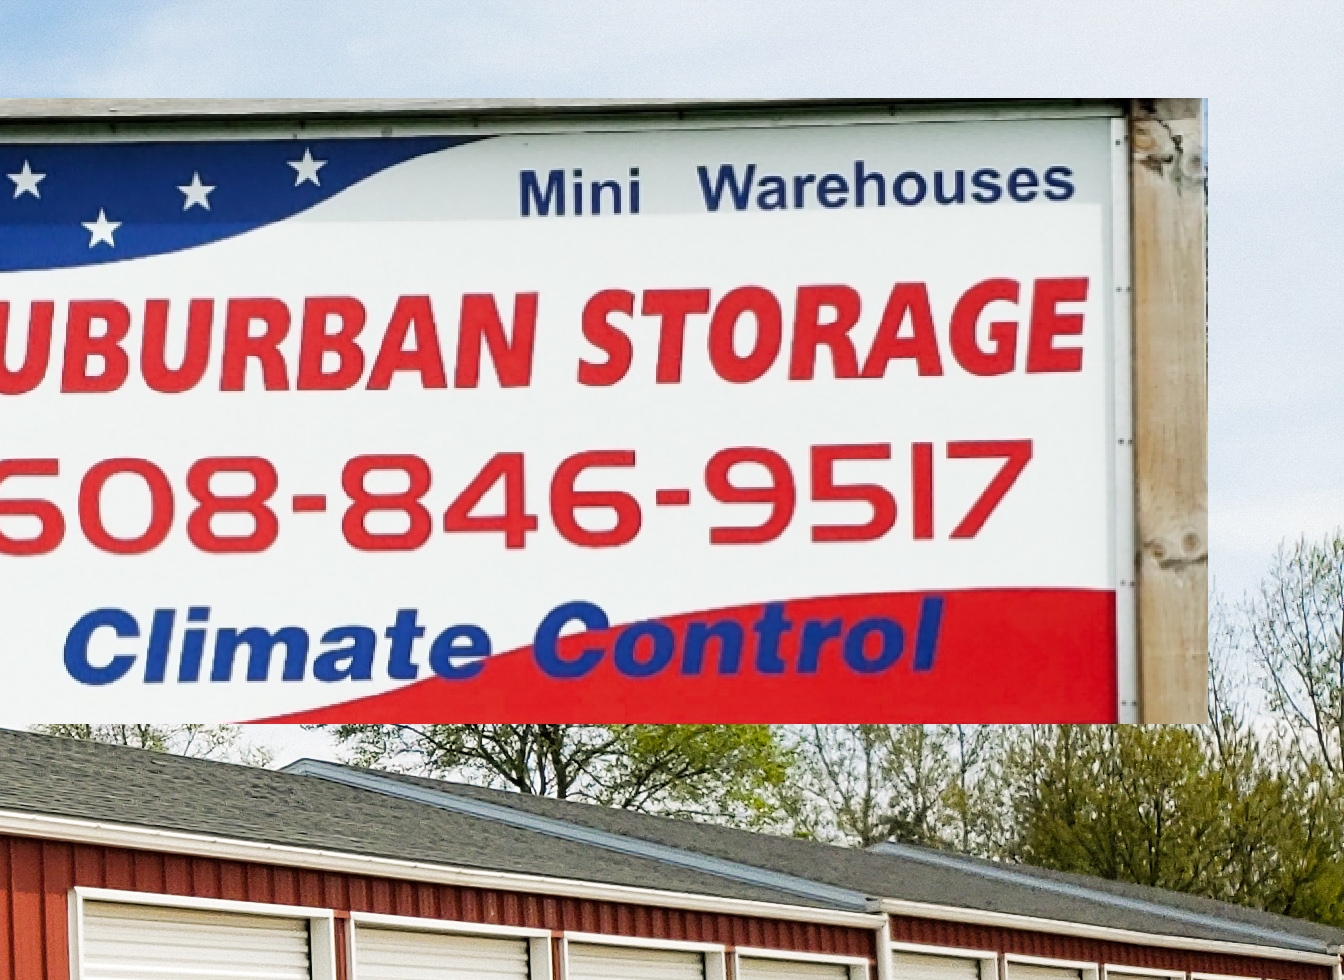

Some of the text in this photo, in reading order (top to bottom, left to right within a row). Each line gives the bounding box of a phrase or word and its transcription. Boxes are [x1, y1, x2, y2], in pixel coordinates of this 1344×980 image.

[519, 160, 1075, 218] Mini Warehouses
[577, 277, 1090, 387] STORAGE
[63, 597, 944, 686] Climate Control
